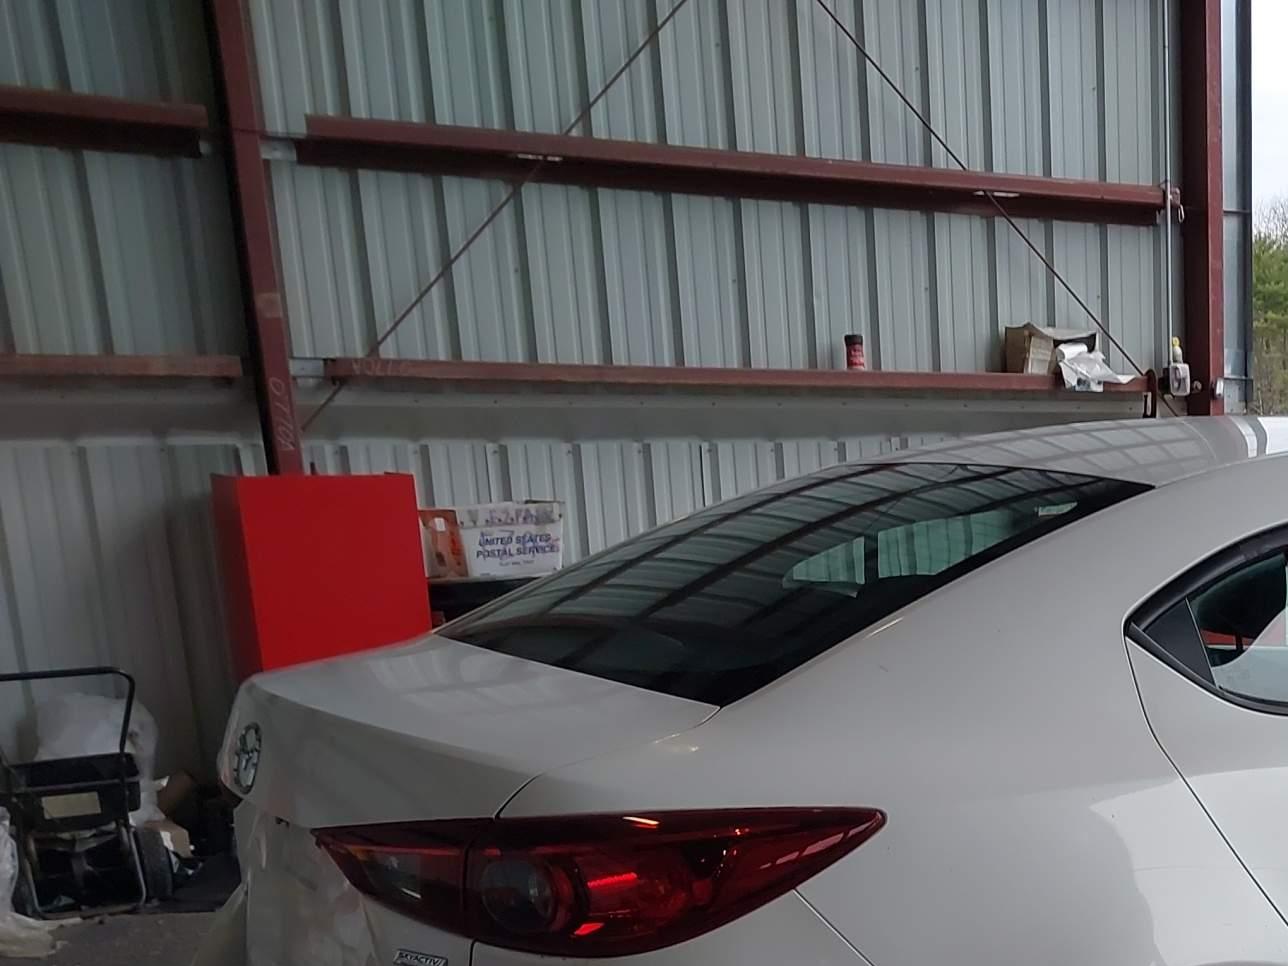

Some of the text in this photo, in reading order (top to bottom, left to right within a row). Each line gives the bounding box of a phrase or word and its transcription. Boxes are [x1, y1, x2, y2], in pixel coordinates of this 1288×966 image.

[479, 533, 551, 546] UNITED STATES
[476, 547, 514, 558] POSTAL
